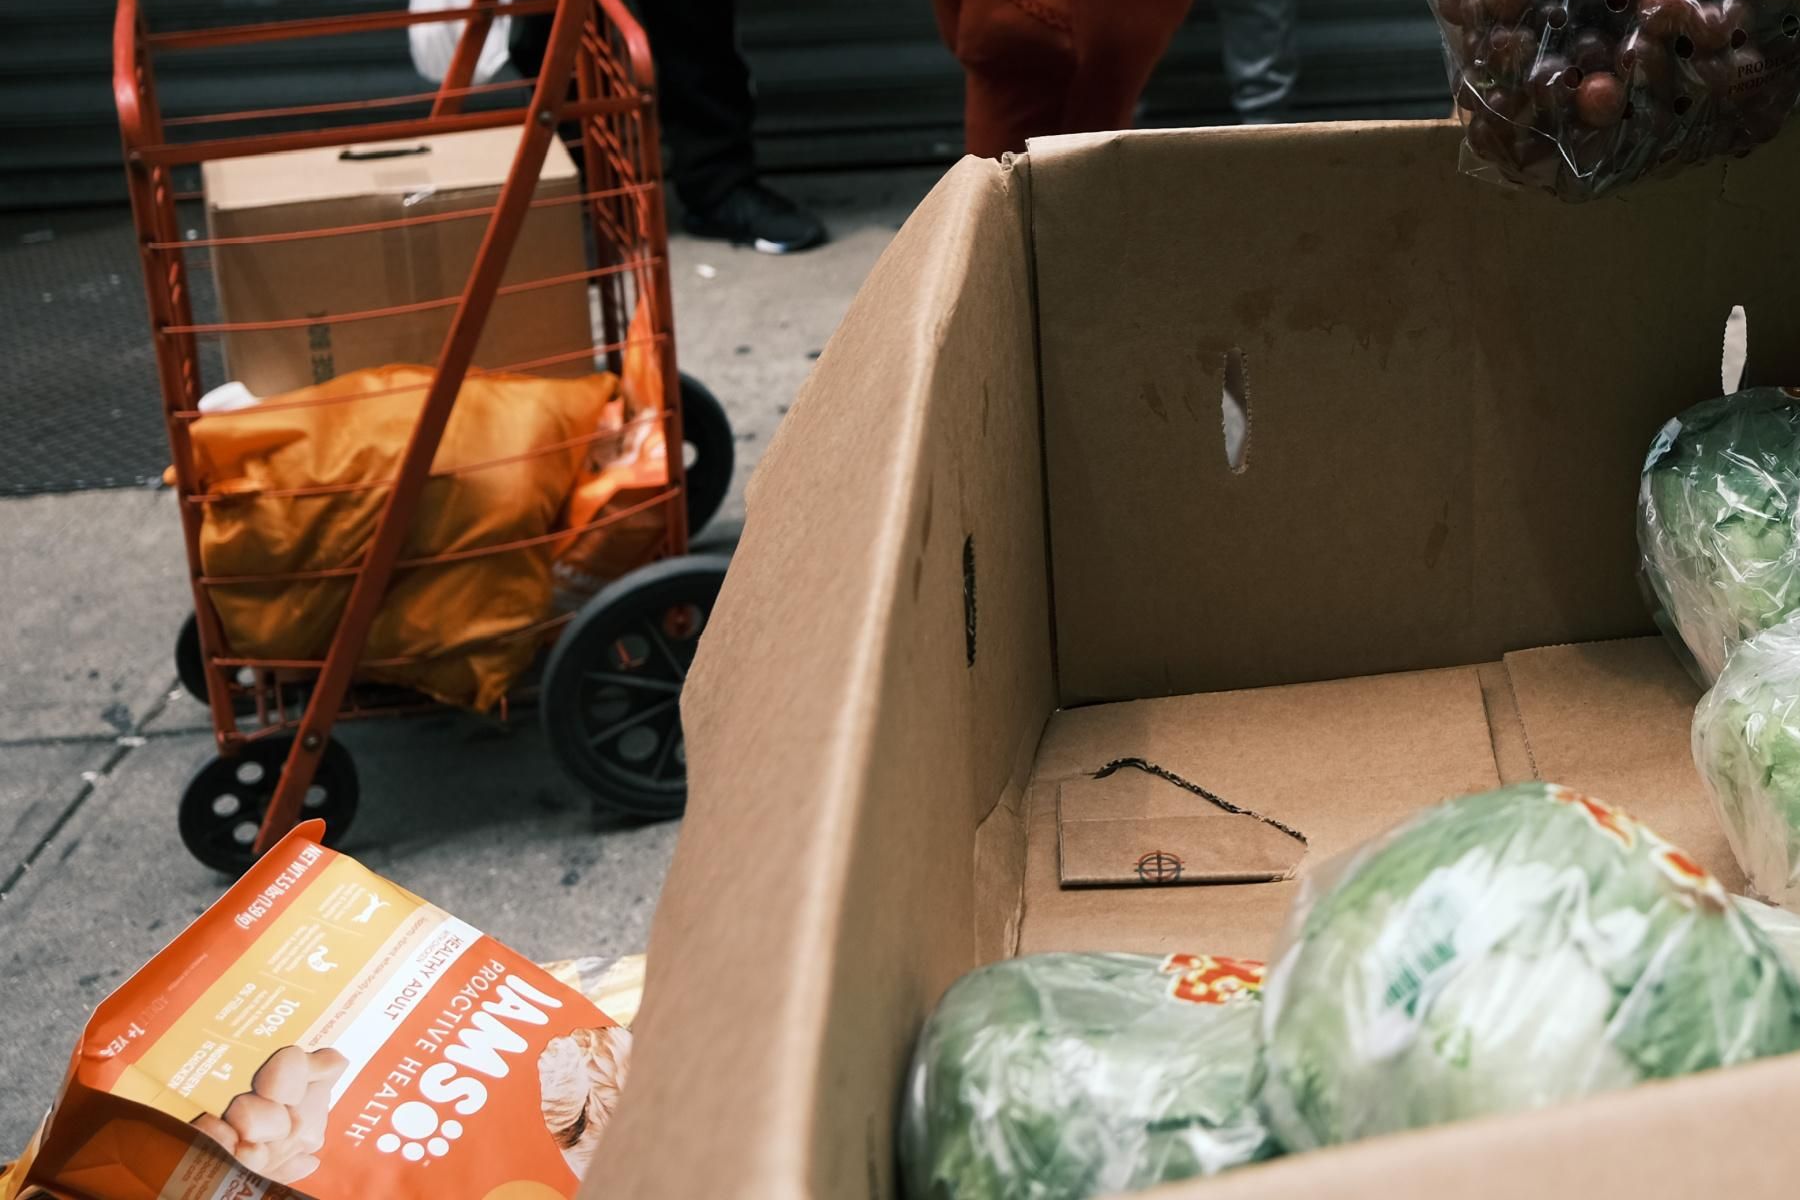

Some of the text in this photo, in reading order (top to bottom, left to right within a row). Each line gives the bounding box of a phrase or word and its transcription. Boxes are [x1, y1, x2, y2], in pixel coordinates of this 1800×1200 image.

[232, 843, 323, 930] NET WT 3.5 lbs (1.59 kg)
[381, 934, 463, 1021] HEALTHY ADULT
[124, 1022, 146, 1040] 1+
[214, 994, 244, 1023] Fillers
[255, 998, 300, 1038] 100%
[98, 1035, 129, 1057] YEA
[166, 1040, 215, 1090] IS CHICKEN
[345, 958, 505, 1143] PROACTIVE HEALTH
[420, 973, 564, 1116] IAMS
[177, 1043, 230, 1098] INGREDIENT
[212, 1061, 233, 1081] #1
